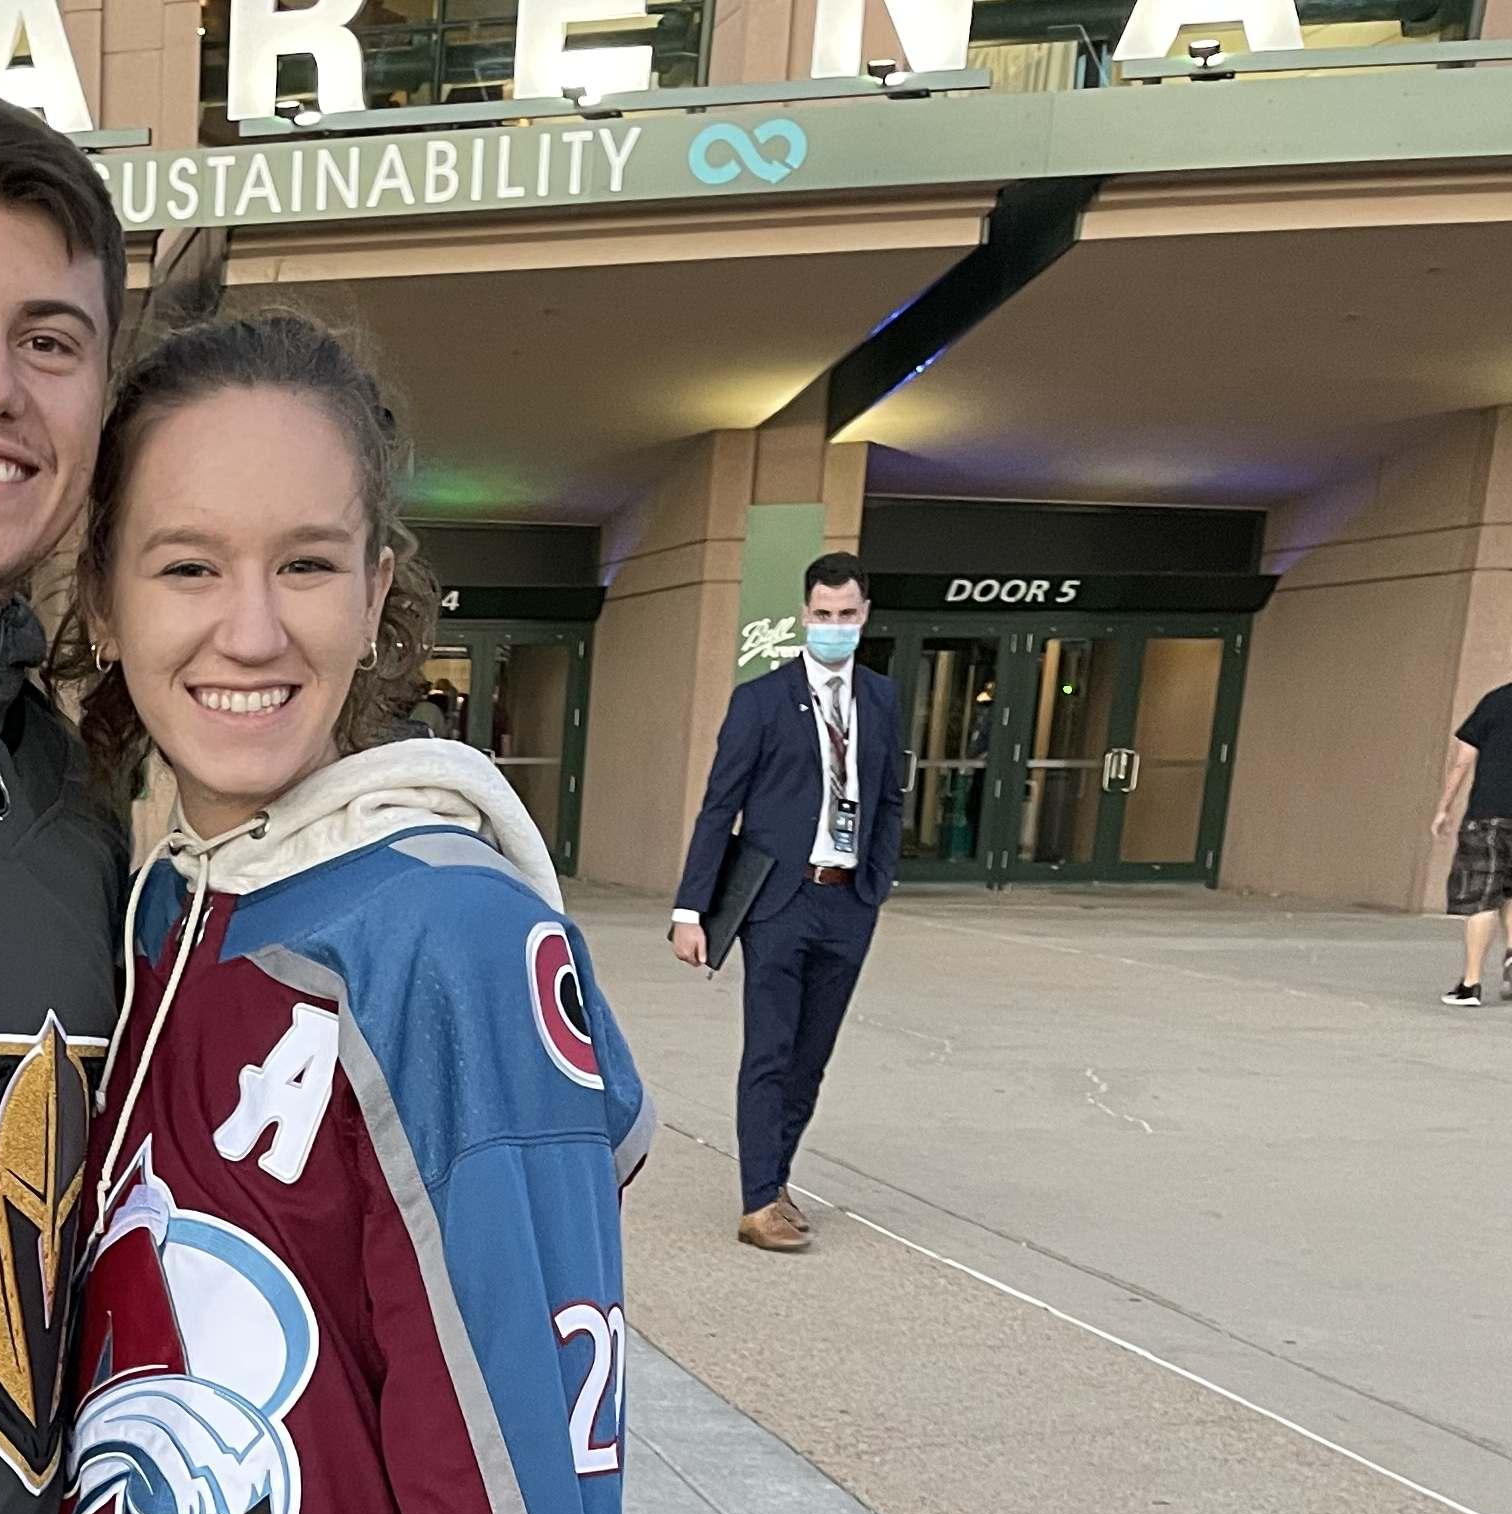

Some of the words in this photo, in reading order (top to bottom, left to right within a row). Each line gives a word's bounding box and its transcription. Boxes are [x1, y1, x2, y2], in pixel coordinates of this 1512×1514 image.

[94, 127, 642, 223] USTAINABILITY
[441, 590, 459, 610] 4
[945, 579, 1049, 603] DOOR
[1054, 579, 1080, 603] 5
[213, 1002, 339, 1184] A
